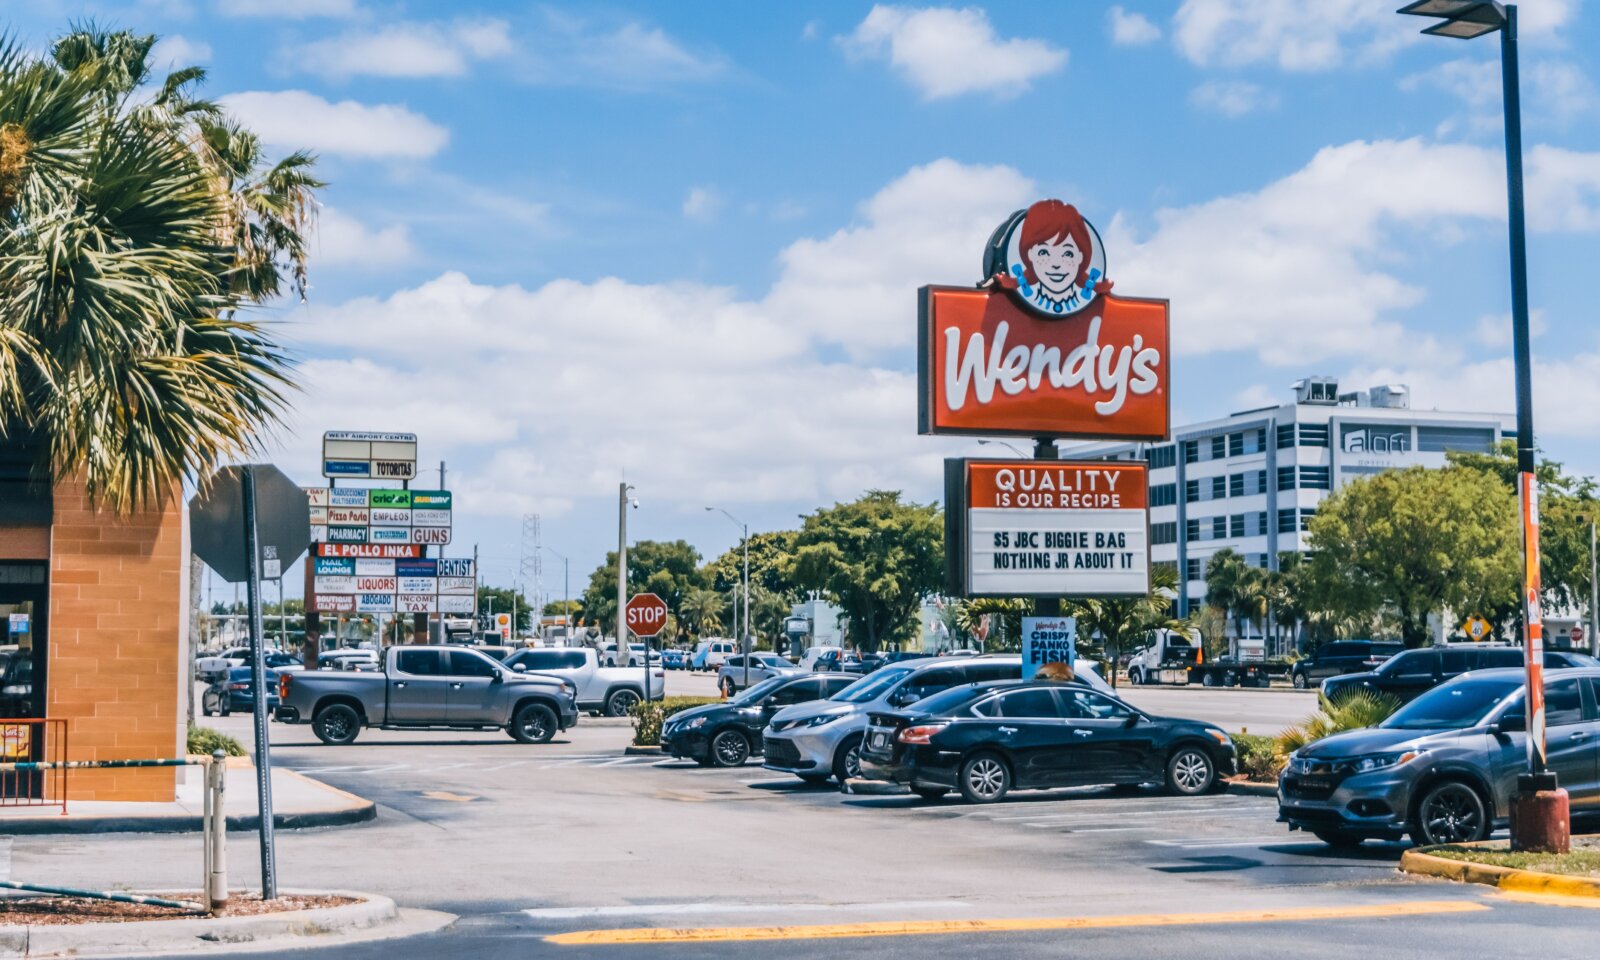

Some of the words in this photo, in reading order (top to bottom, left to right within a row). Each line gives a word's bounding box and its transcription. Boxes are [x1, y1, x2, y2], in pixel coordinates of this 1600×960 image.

[944, 316, 1160, 415] Wendy's
[1344, 428, 1406, 454] aloft
[377, 462, 411, 476] TOTORITAS
[995, 469, 1120, 492] QUALITY
[332, 497, 366, 505] MULTISERVICE
[372, 494, 409, 504] cricket
[414, 495, 450, 503] SUBWAY
[996, 493, 1010, 507] IS
[1017, 493, 1053, 507] OUR
[1060, 493, 1121, 508] RECIPE
[329, 510, 347, 521] Pizza
[373, 511, 409, 521] EMPLEOS
[330, 528, 366, 540] PHARMACY
[414, 529, 447, 543] GUNS
[1014, 532, 1039, 548] JBC
[1044, 532, 1088, 548] BIGGIE
[1095, 532, 1126, 548] BAG
[324, 544, 339, 556] EL
[342, 544, 380, 557] POLLO
[383, 545, 413, 557] INKA
[993, 553, 1051, 569] NOTHING
[1055, 553, 1069, 569] JR
[1074, 553, 1115, 569] ABOUT
[1121, 553, 1133, 569] IT
[439, 560, 471, 576] DENTIST
[357, 578, 395, 590] LIQUORS
[361, 594, 391, 605] ABOGADO
[405, 603, 428, 611] TAX
[628, 606, 664, 624] STOP
[1031, 631, 1069, 640] CRISPY
[1031, 640, 1070, 650] PANKO
[1031, 650, 1069, 664] FISH
